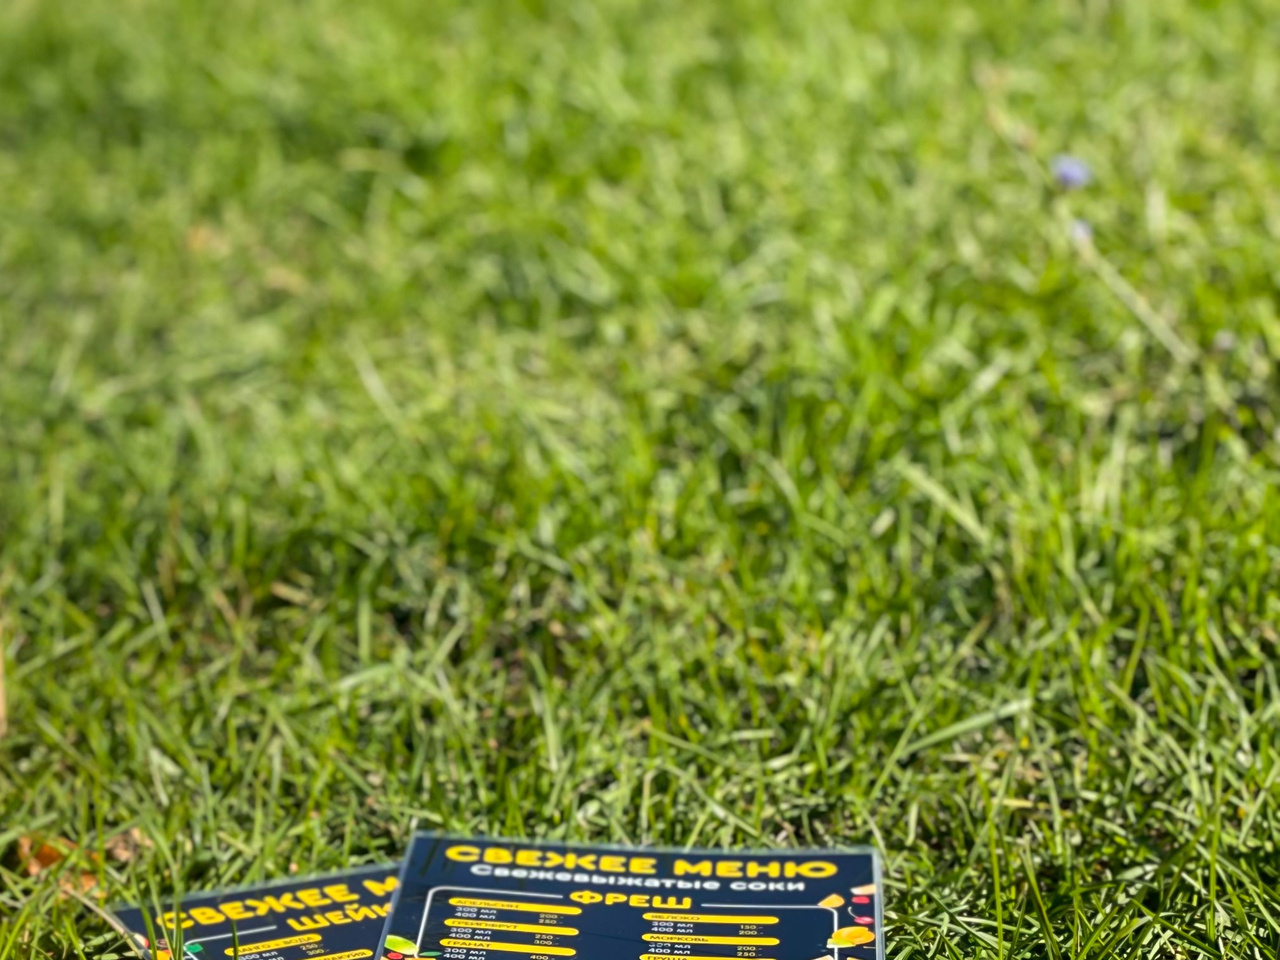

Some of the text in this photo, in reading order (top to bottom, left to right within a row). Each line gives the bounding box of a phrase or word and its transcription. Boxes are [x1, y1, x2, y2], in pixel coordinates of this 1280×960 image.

[445, 845, 838, 878] СВЕЖЕЕ МЕНЮ
[470, 864, 806, 891] Свежевыжатые соки
[156, 884, 359, 929] СВЕЖЕЕ
[570, 890, 692, 909] ФРЕШ
